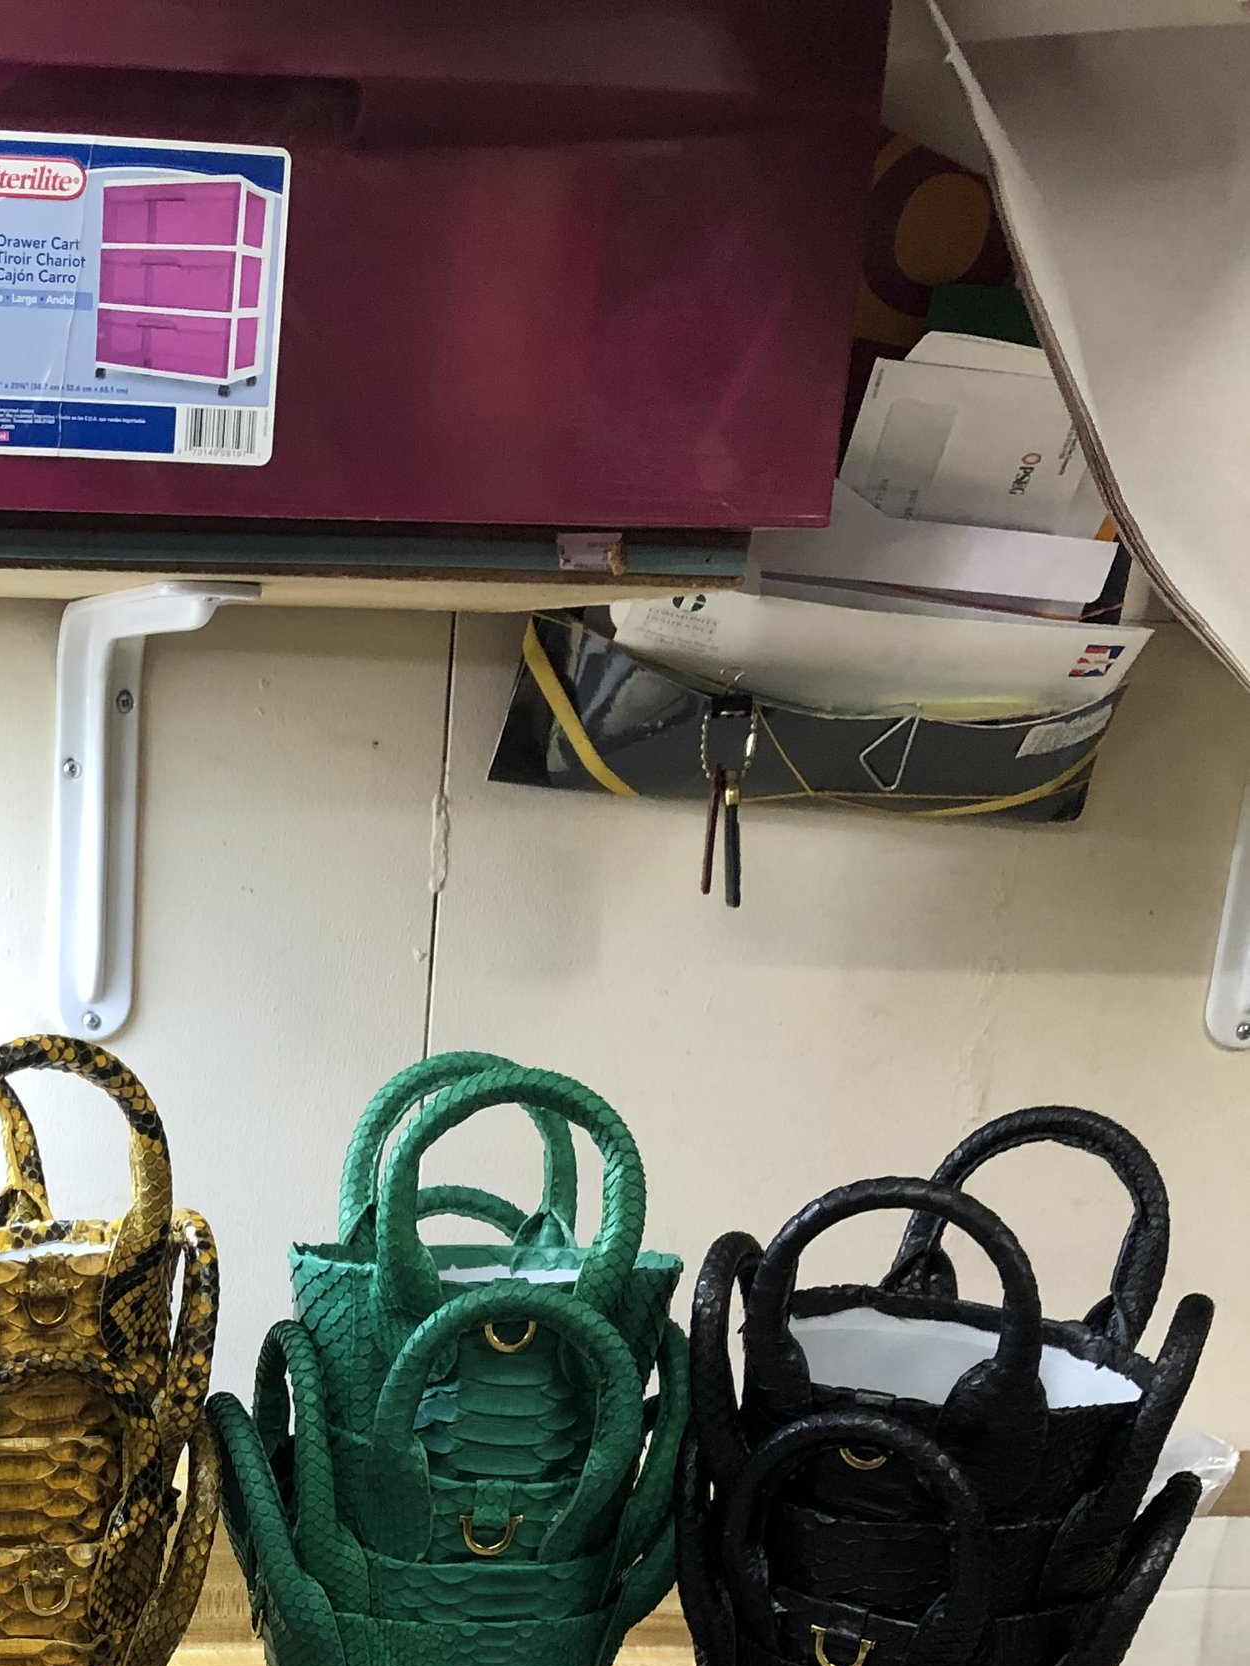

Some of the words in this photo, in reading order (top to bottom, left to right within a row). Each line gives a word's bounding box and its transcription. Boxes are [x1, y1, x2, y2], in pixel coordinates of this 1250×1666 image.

[51, 236, 81, 251] Cart
[36, 252, 86, 268] Chariot
[38, 269, 76, 284] Carro
[11, 293, 37, 305] Large
[45, 294, 75, 305] Ancho
[1008, 465, 1035, 497] PSEG
